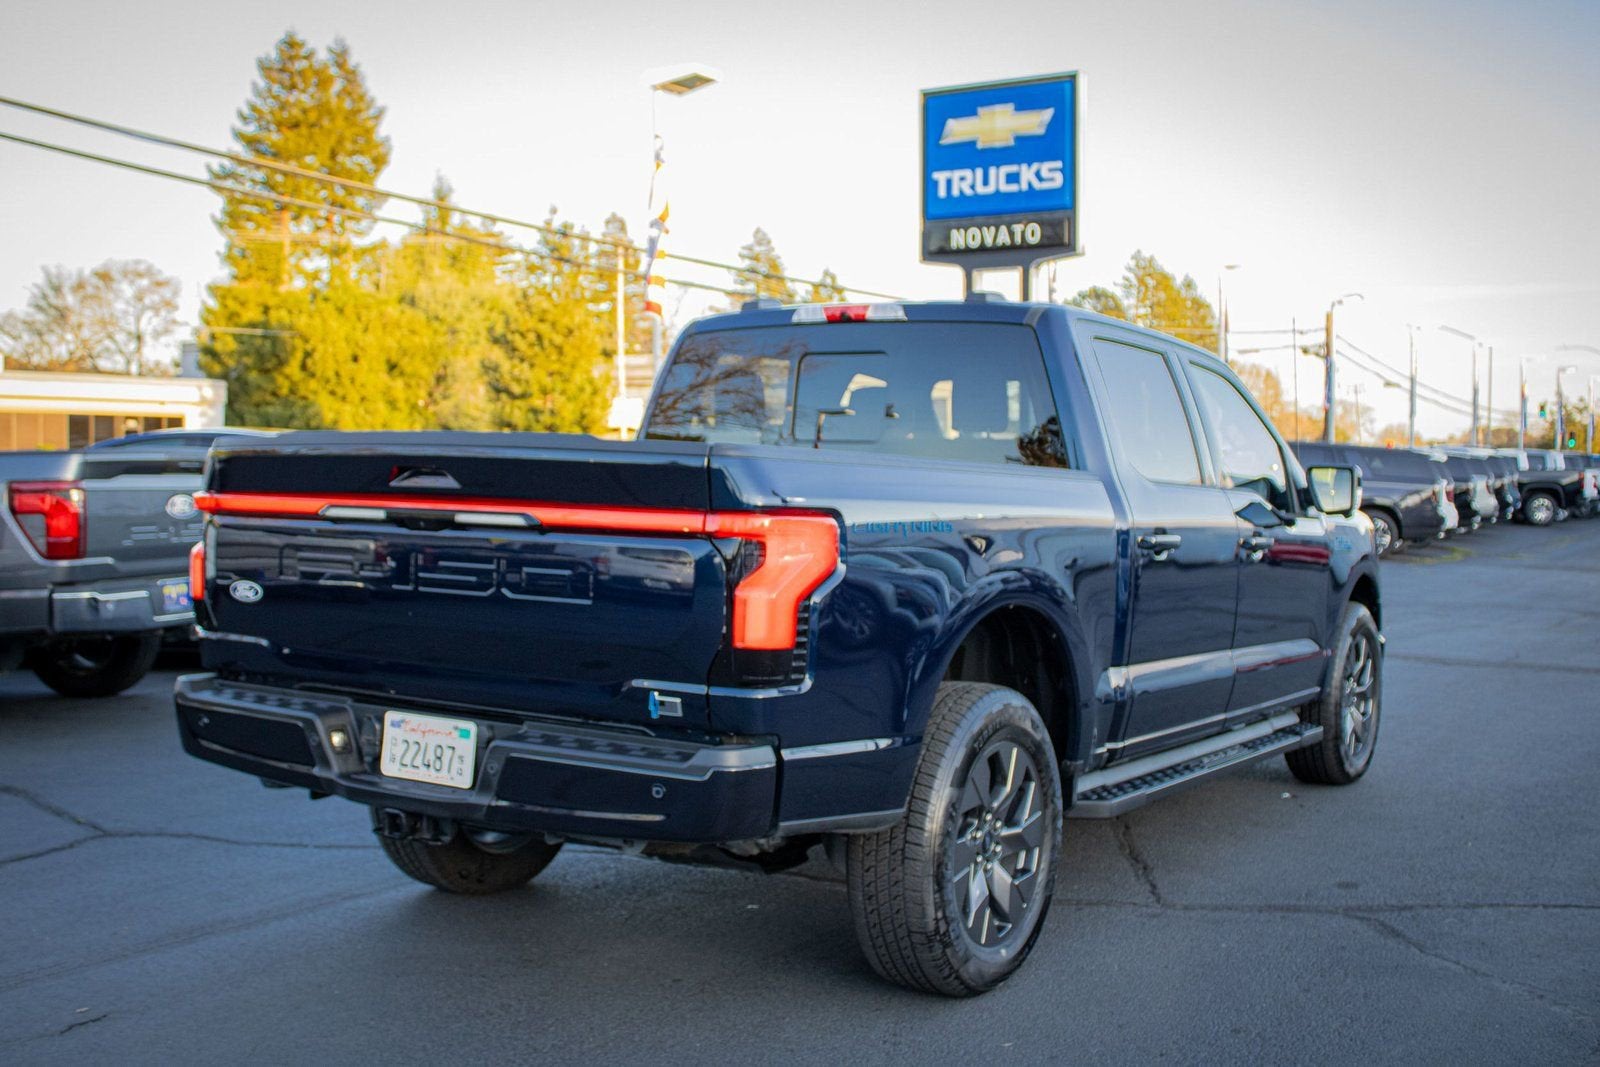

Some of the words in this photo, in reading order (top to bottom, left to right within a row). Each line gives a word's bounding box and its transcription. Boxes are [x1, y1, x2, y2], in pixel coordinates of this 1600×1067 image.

[931, 160, 1064, 199] TRUCKS
[950, 222, 1042, 250] NOVATO
[399, 739, 456, 773] 22487
